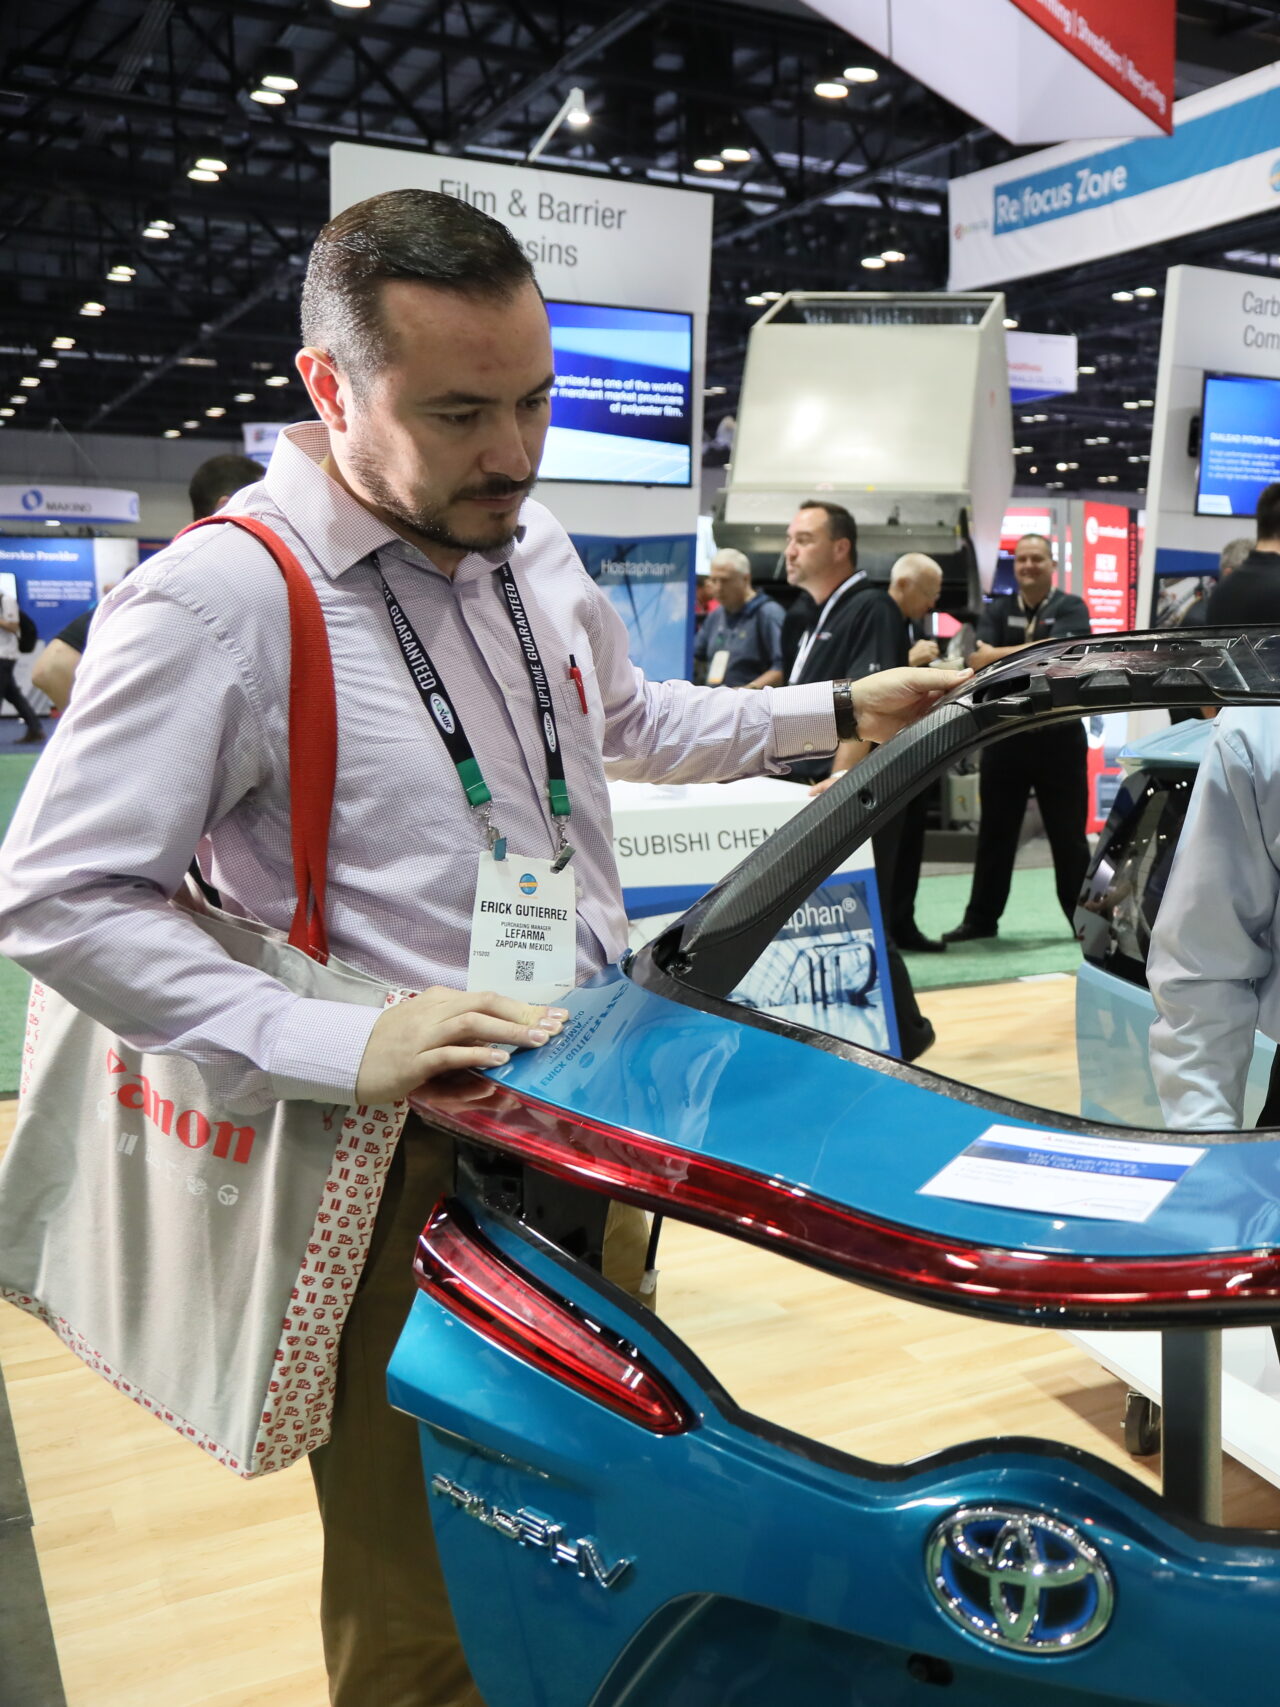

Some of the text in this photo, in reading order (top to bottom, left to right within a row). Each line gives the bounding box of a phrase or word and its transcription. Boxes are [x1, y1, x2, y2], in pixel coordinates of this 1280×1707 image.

[508, 189, 527, 218] &
[538, 192, 627, 230] Barrier
[519, 236, 578, 267] sins
[46, 502, 92, 513] MAKINO
[390, 604, 437, 690] GUARANTEED
[505, 582, 551, 709] UPTIME GUARANTEED
[613, 831, 710, 857] SUBISHI
[480, 900, 568, 921] ERICK GUTIERREZ
[501, 921, 530, 930] PURCHASING
[505, 928, 546, 941] LEFARMA
[495, 940, 553, 952] ZAPOPAN MEXICO
